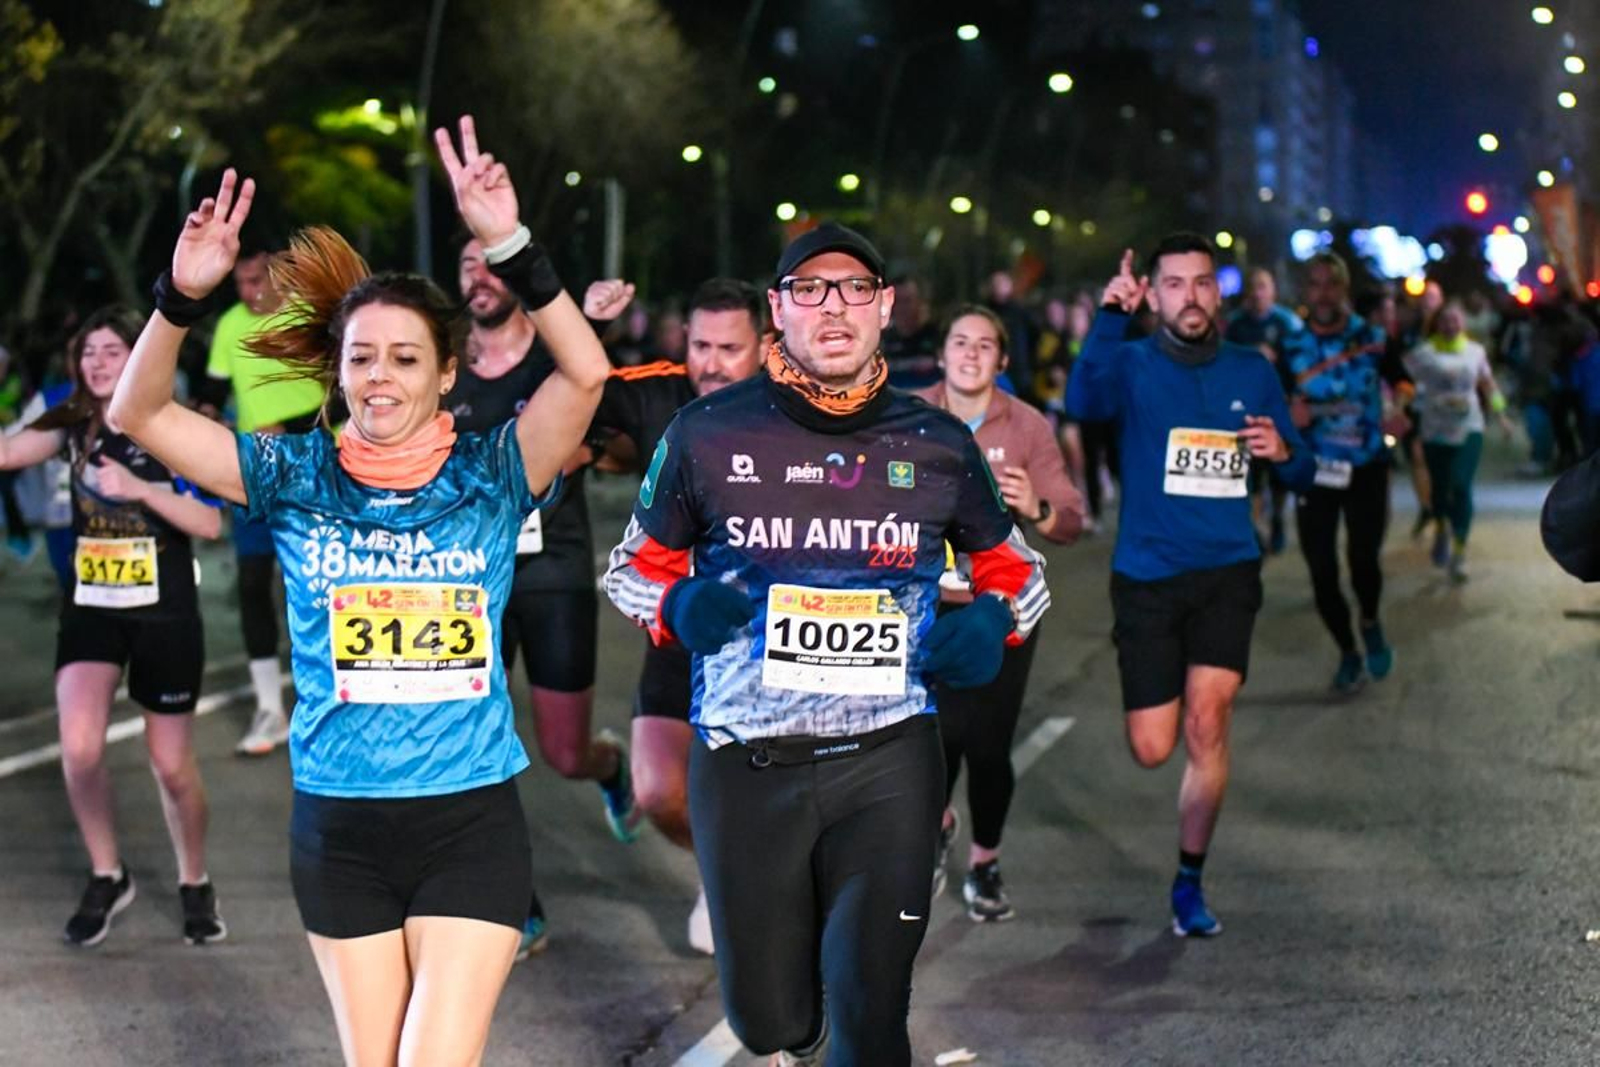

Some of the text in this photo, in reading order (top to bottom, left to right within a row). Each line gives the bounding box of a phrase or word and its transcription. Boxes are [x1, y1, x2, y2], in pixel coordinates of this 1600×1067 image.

[1175, 448, 1243, 472] 8558
[725, 512, 920, 553] SAN ANTÓN
[81, 557, 147, 581] 3175
[301, 540, 347, 579] 38
[350, 541, 487, 579] MARATÓN
[869, 543, 918, 569] 2025
[367, 589, 394, 609] 42
[801, 593, 826, 612] 42
[345, 617, 476, 656] 3143
[774, 617, 901, 653] 10025
[813, 742, 860, 756] new balance
